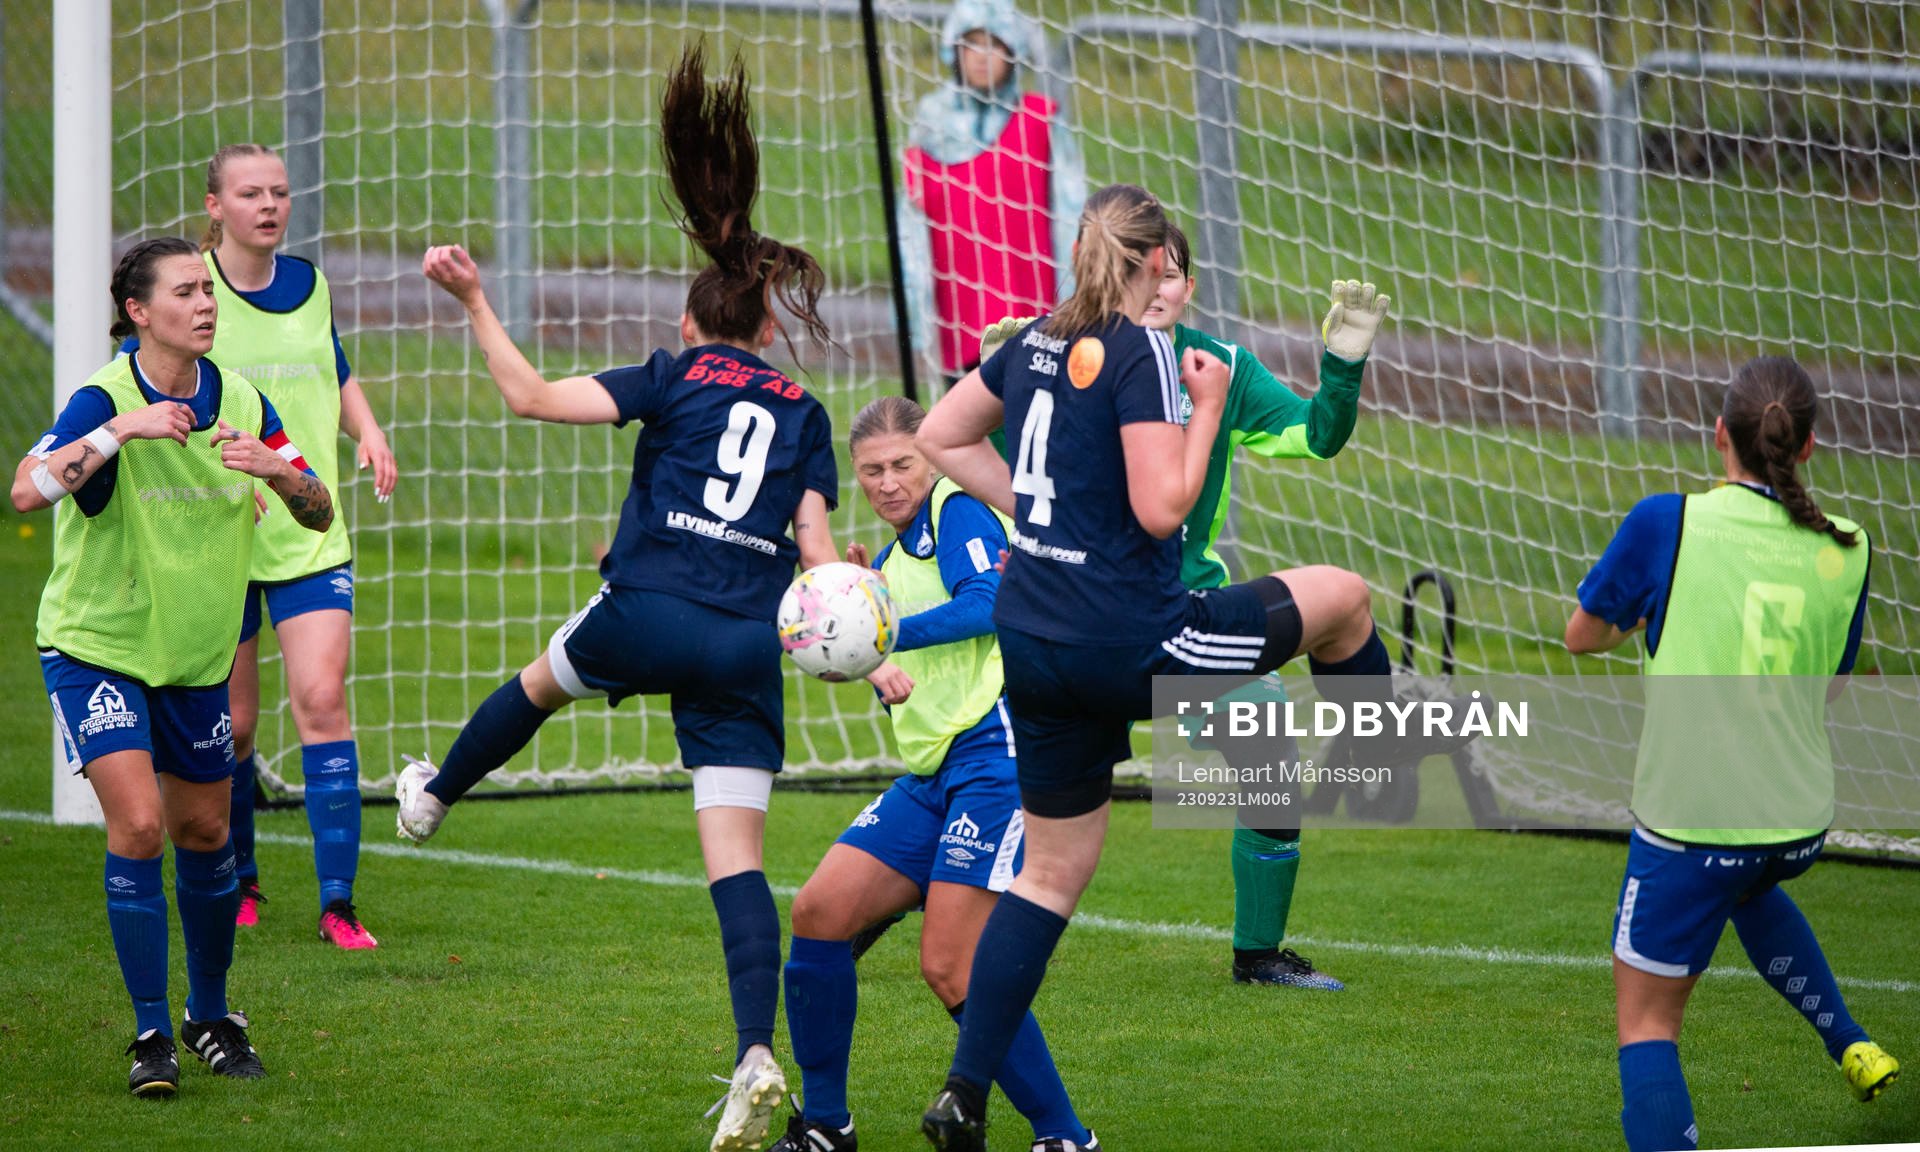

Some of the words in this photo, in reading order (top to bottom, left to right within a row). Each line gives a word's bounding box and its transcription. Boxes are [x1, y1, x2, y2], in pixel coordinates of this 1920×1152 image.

[684, 364, 753, 388] Bygg
[761, 379, 804, 400] AB
[703, 400, 776, 522] 9
[1011, 388, 1057, 527] 4
[78, 714, 139, 733] BYGGKONSULT
[87, 693, 127, 718] SM
